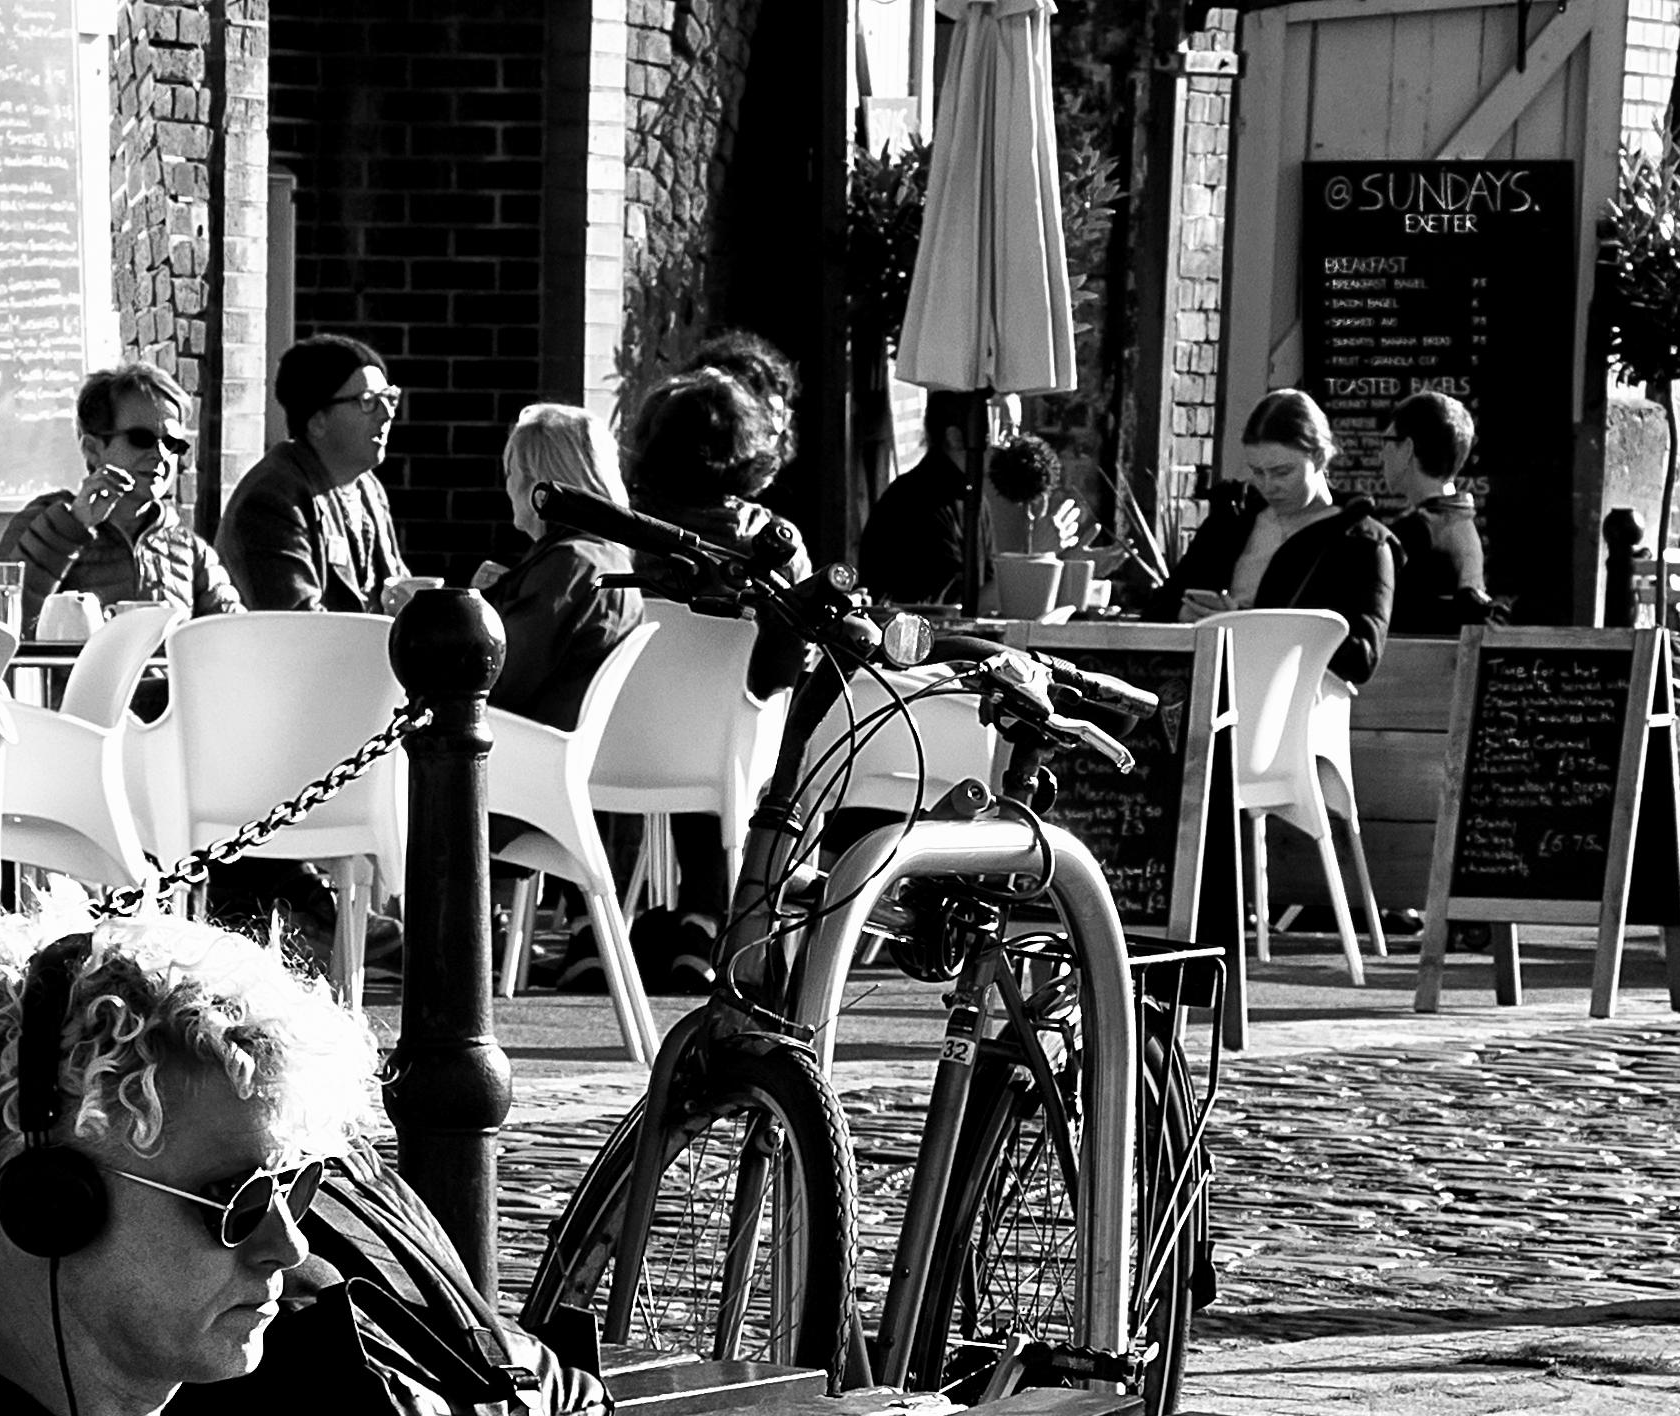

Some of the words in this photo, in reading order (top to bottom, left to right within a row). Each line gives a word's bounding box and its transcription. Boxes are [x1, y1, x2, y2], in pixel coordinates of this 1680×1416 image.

[1404, 213, 1478, 233] EXETER
[1325, 256, 1408, 275] BREAKFAST
[1332, 278, 1387, 290] BREAKFAST
[1393, 278, 1429, 290] BAGEL
[1367, 298, 1400, 309] BAGEL
[1324, 376, 1401, 396] TOASTED
[1410, 376, 1471, 396] BAGELS
[943, 1039, 969, 1062] 32
